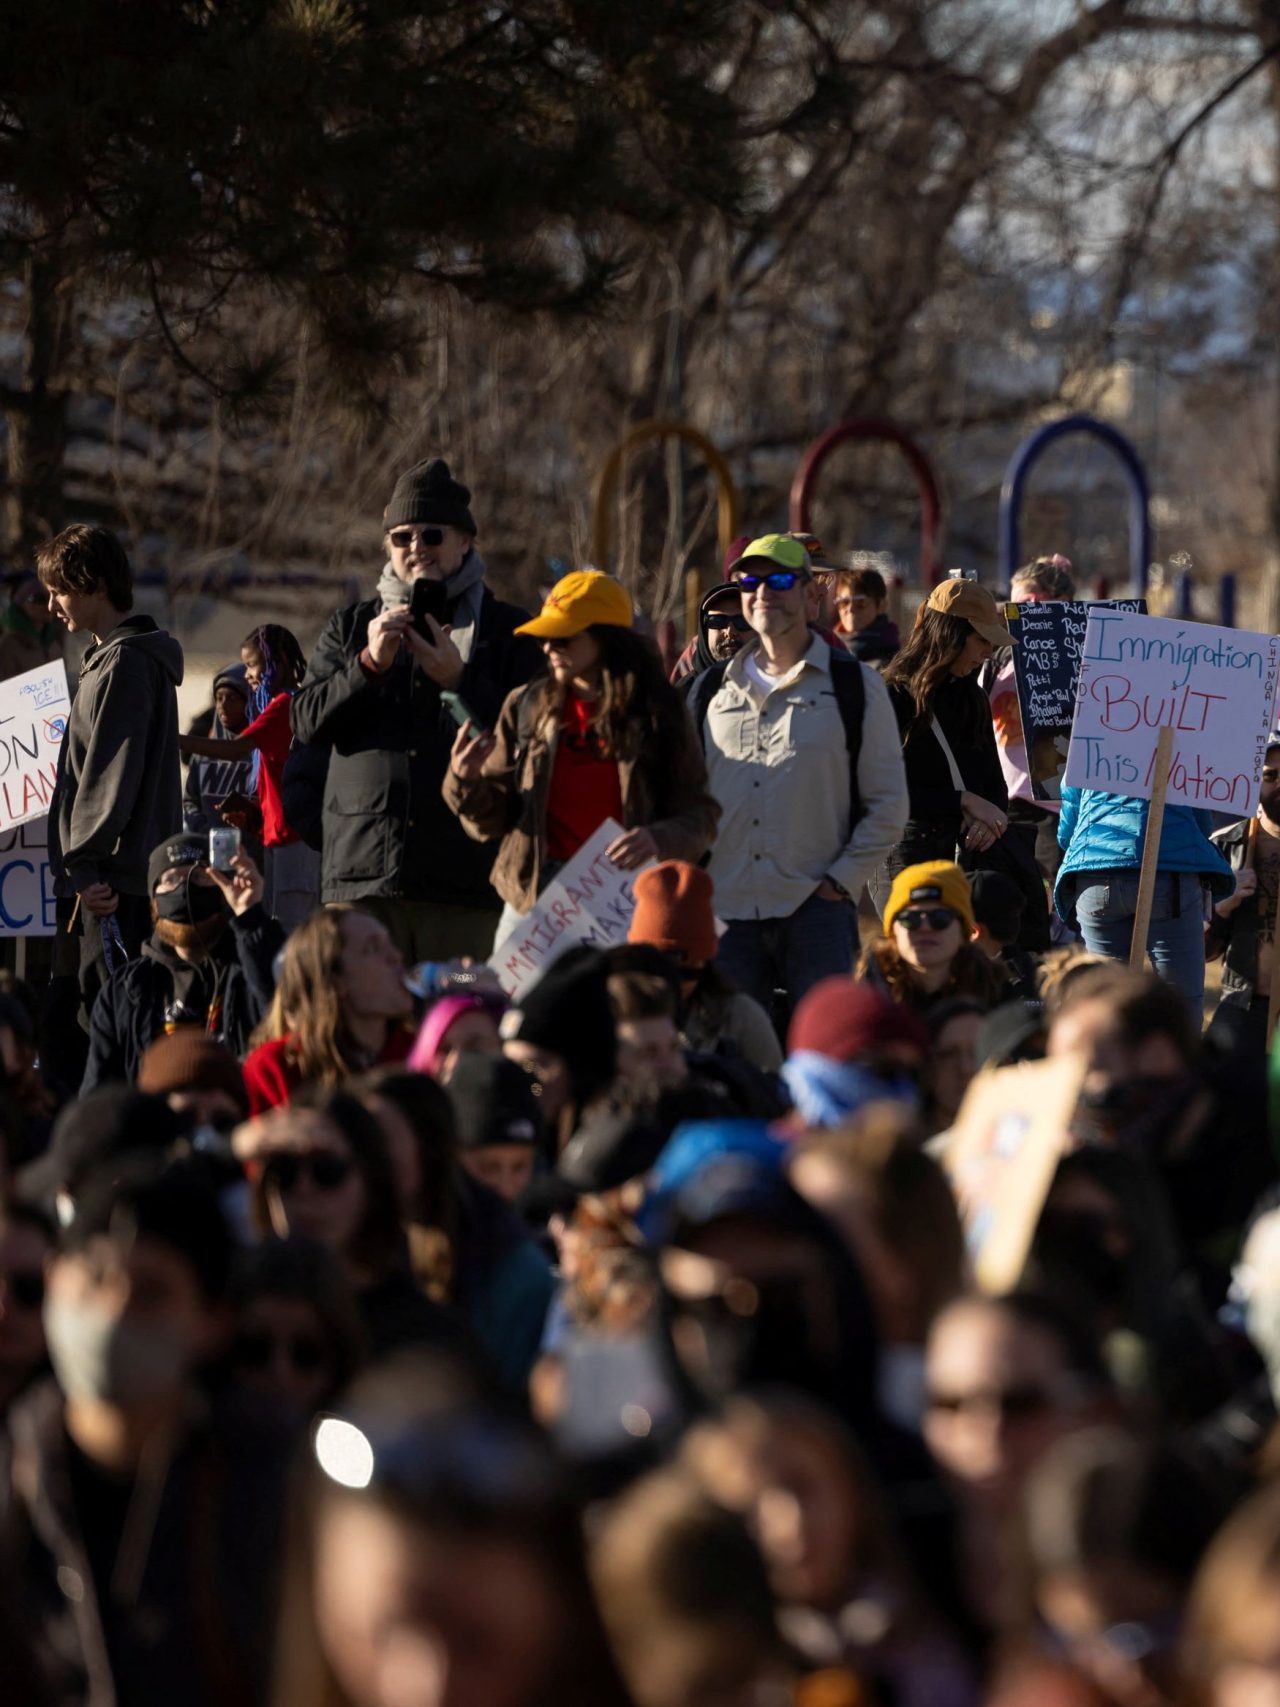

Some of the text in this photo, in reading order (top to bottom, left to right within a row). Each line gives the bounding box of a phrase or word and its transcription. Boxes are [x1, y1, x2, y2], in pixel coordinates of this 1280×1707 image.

[1025, 673, 1051, 690] Patti
[1083, 616, 1263, 687] Immigration
[1264, 637, 1280, 701] CHINGA
[199, 757, 259, 797] NIK
[1073, 736, 1251, 810] This Nation
[0, 858, 58, 929] CE
